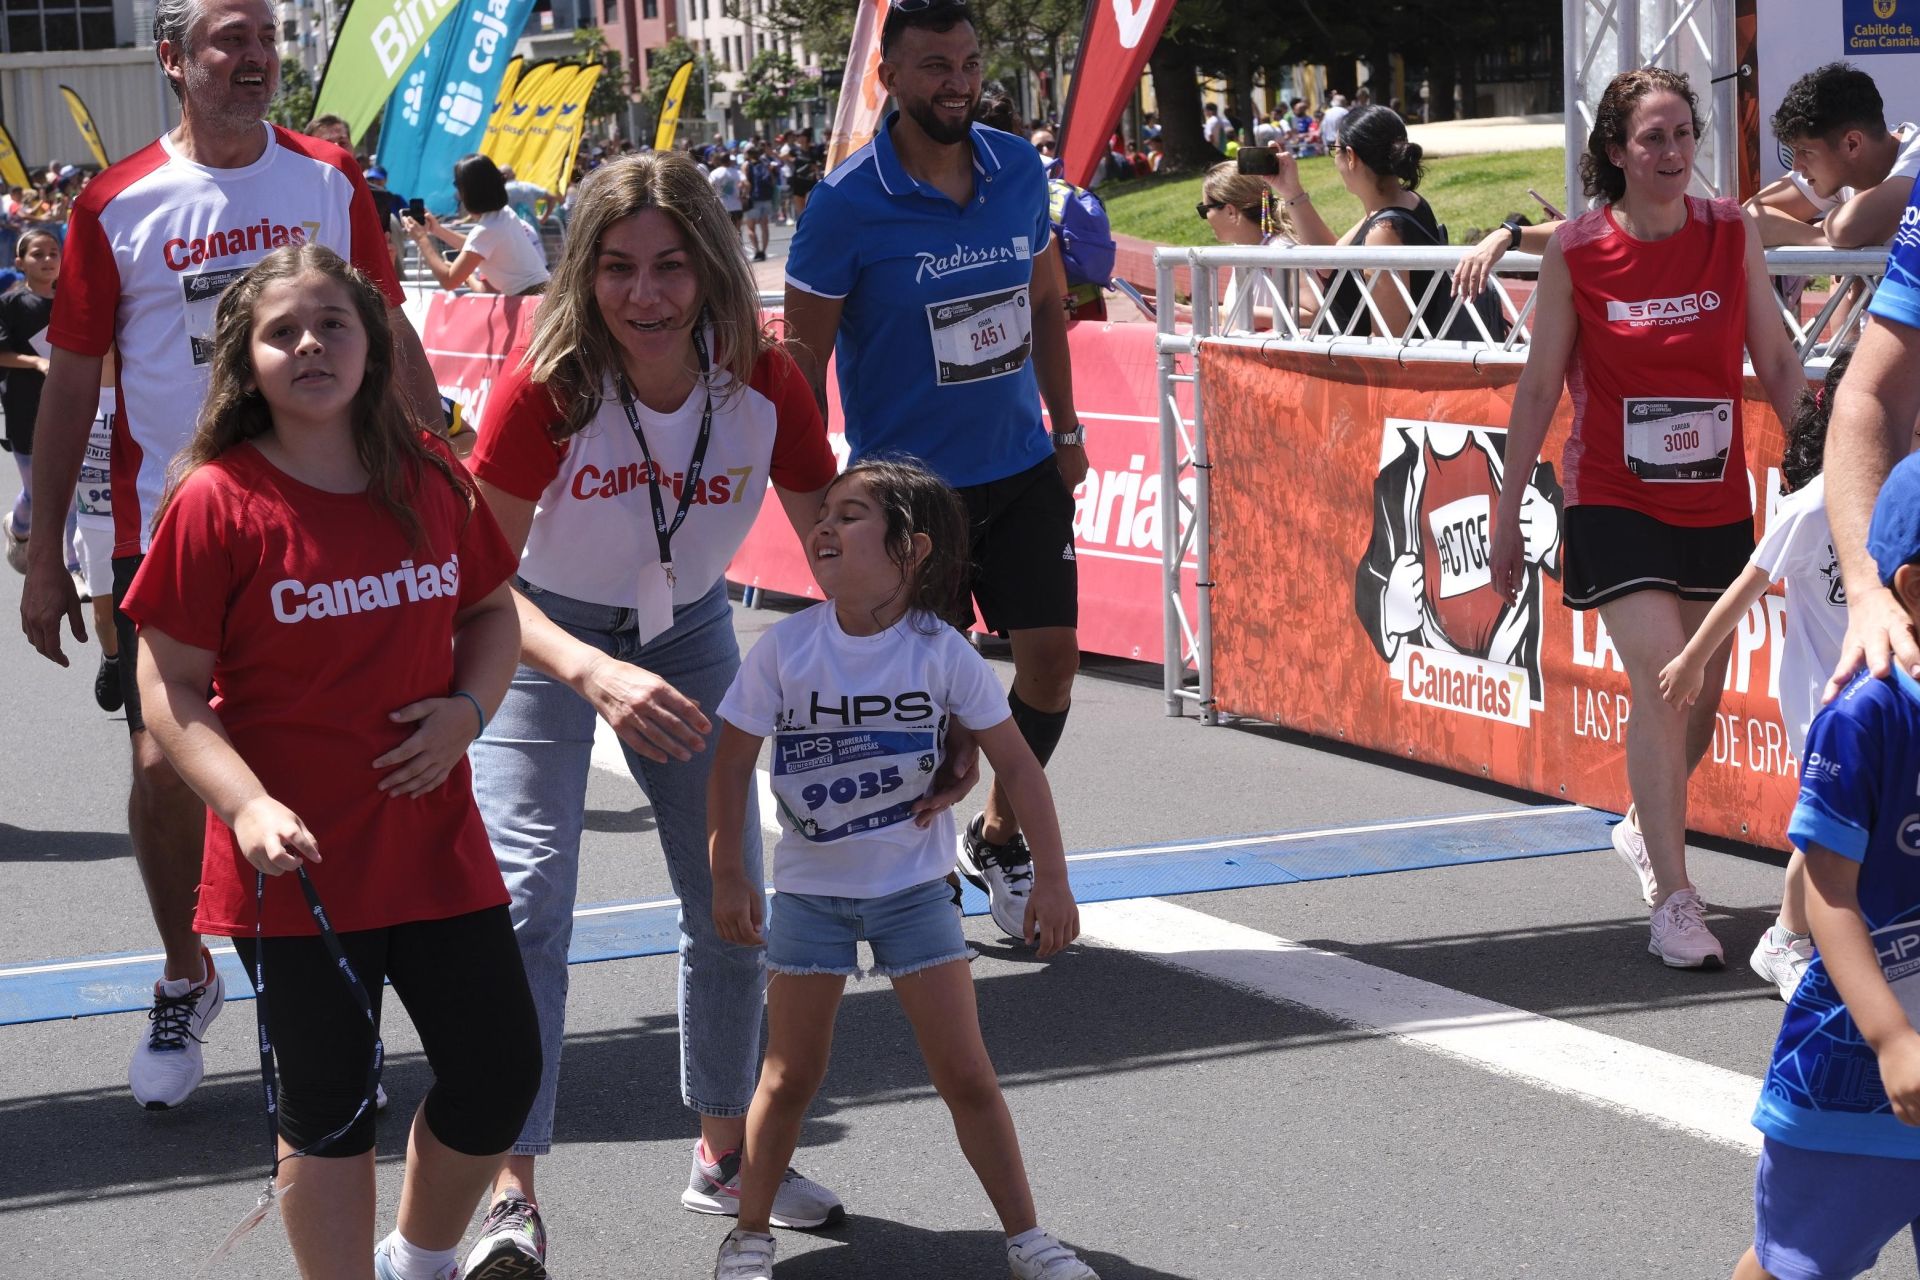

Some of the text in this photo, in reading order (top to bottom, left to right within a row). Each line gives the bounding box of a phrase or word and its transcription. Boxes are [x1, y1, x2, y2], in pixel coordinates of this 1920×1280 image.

[1850, 35, 1920, 48] Gran Canaria
[1854, 23, 1912, 36] Cabildo de
[163, 217, 320, 271] Canarias7
[915, 243, 1013, 284] Radisson
[1629, 298, 1697, 317] SPAR
[1630, 314, 1700, 327] GRAN CANARIA
[970, 322, 1007, 352] 2451
[1663, 430, 1700, 453] 3000
[89, 489, 112, 503] 90
[1438, 513, 1490, 577] #C7CE
[270, 553, 459, 624] Canarias
[1572, 609, 1624, 673] LA
[1408, 651, 1525, 720] Canarias7
[810, 691, 934, 726] HPS
[782, 736, 833, 762] HPS
[836, 736, 864, 748] CARRERA
[863, 734, 872, 743] DE
[1573, 685, 1611, 742] LAS
[1713, 712, 1742, 768] DE
[1747, 718, 1798, 779] GRA
[838, 747, 849, 757] LAS
[848, 741, 879, 755] EMPRESAS
[801, 765, 904, 812] 9035
